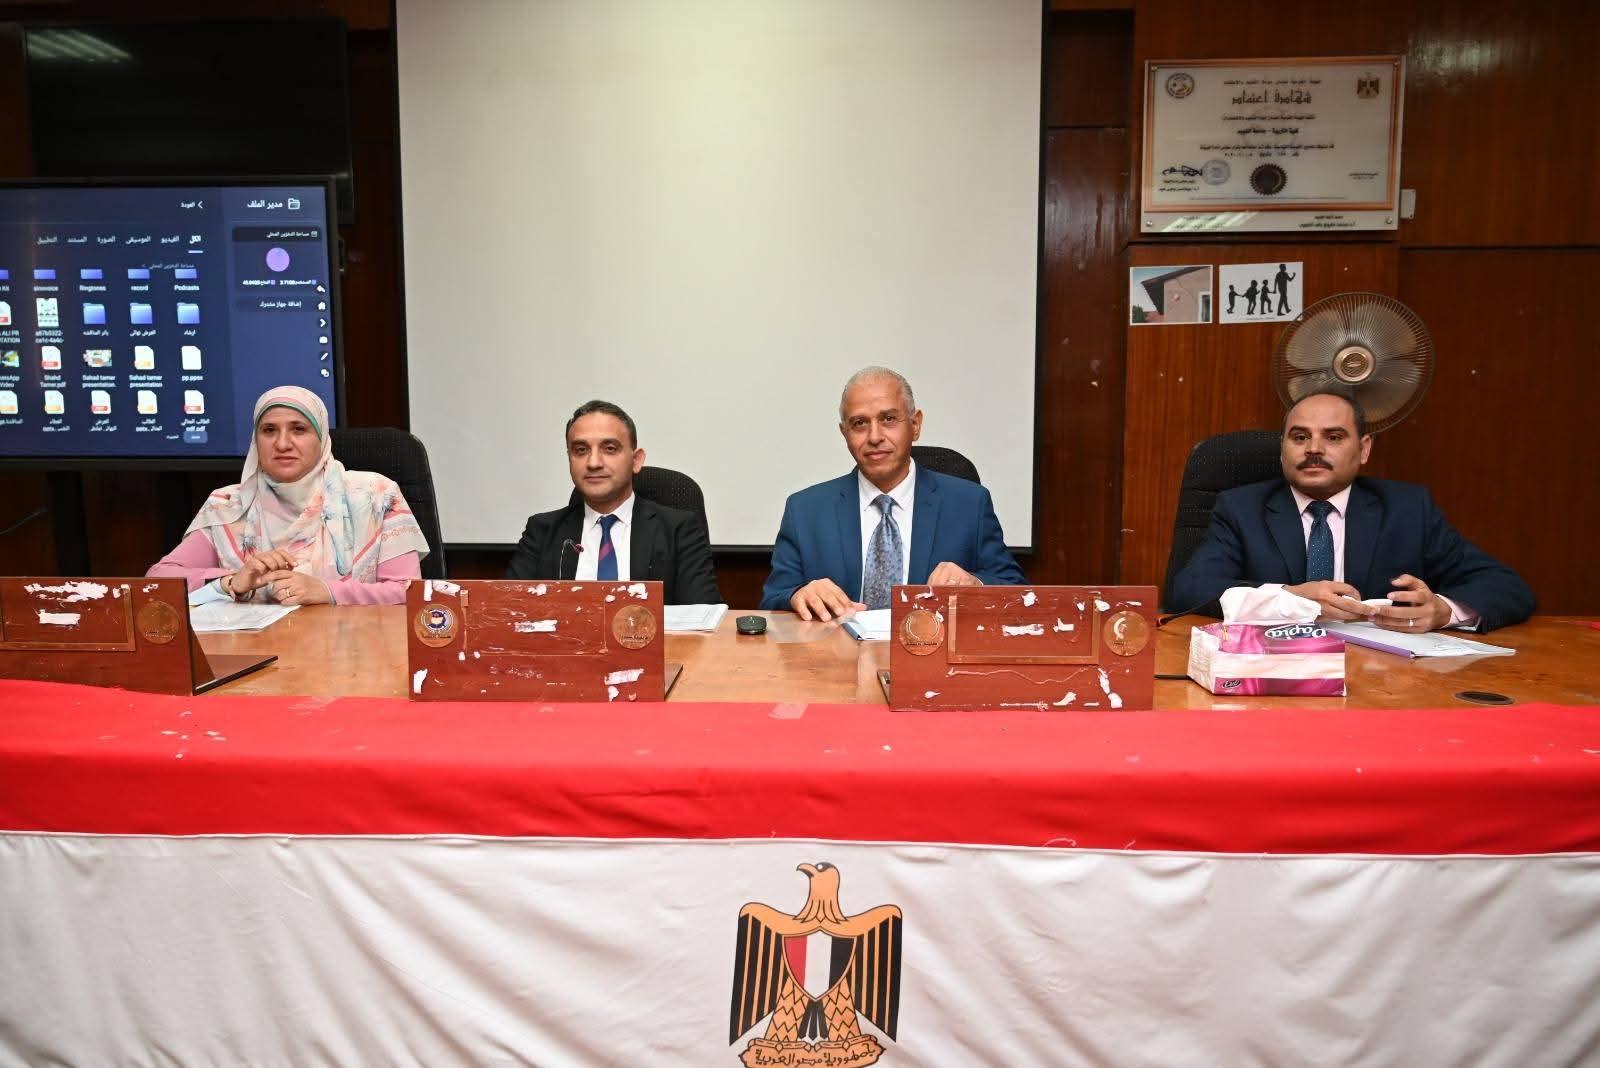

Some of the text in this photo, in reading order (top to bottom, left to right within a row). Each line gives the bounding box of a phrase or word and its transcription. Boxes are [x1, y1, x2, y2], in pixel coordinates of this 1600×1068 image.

[247, 200, 283, 210] مدير الملف
[160, 235, 180, 244] الفيديو
[1271, 624, 1326, 640] Papia
[755, 1048, 795, 1066] العربية
